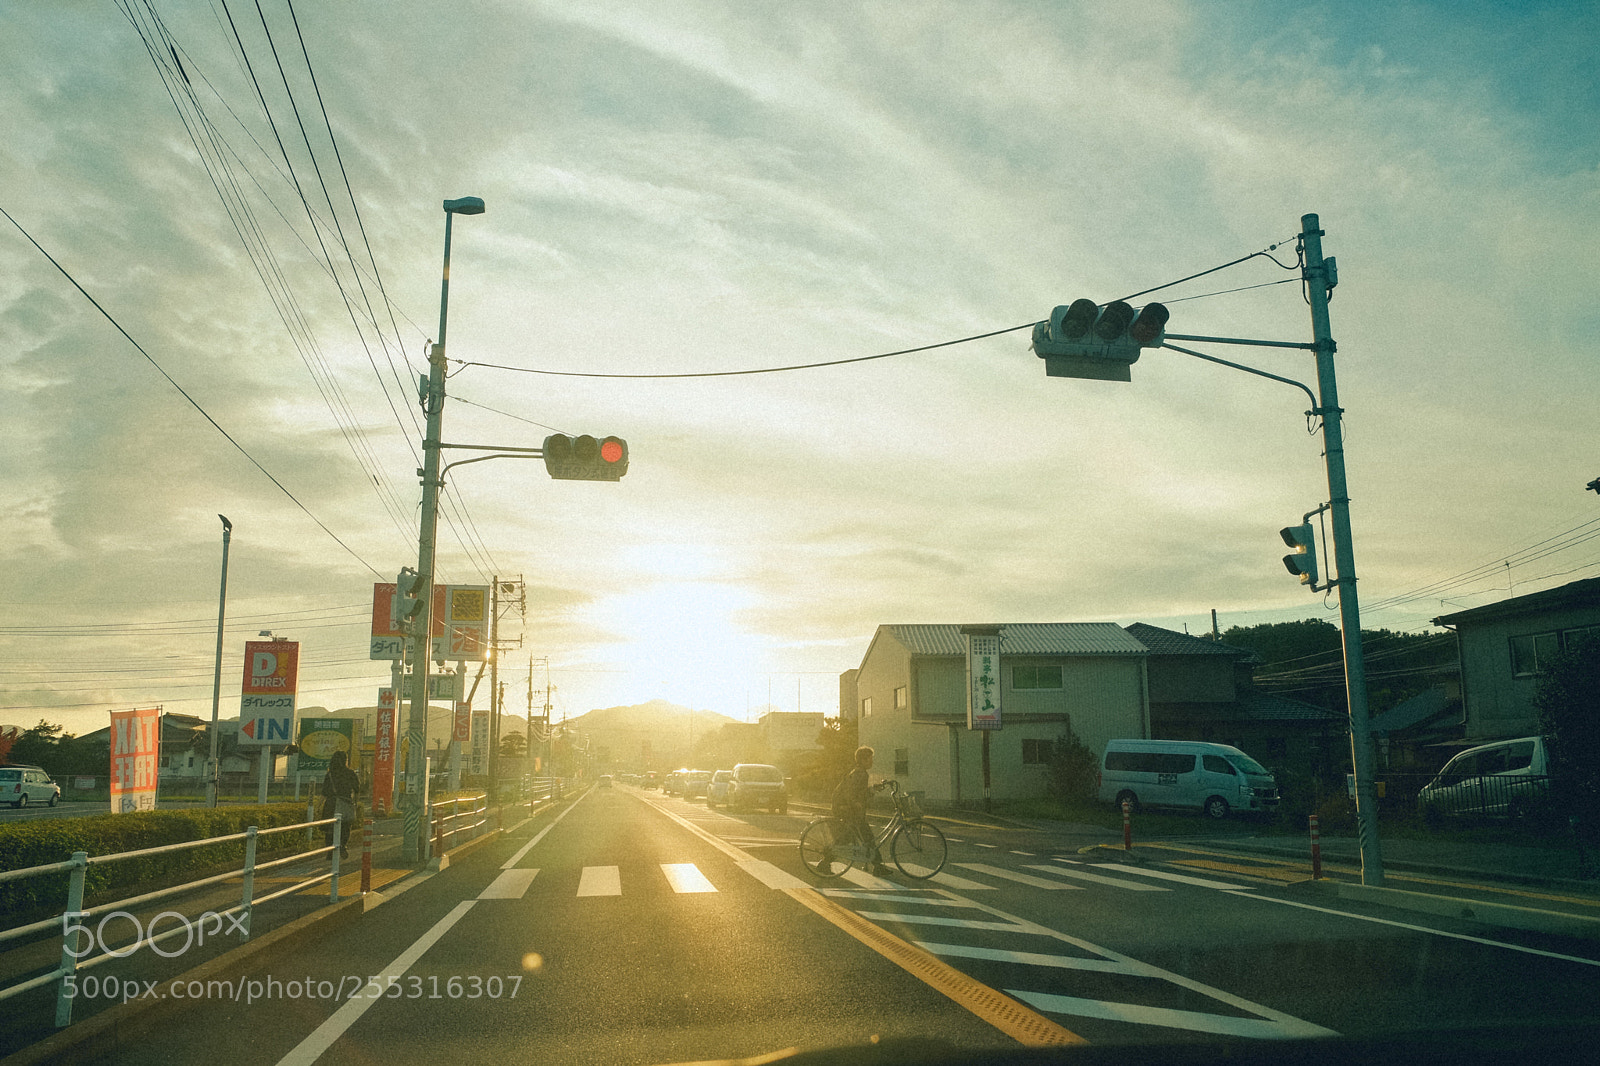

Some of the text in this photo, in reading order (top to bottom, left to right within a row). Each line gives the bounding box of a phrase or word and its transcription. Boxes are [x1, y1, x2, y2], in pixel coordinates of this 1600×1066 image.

[452, 626, 480, 653] 酒
[243, 697, 292, 708] ダイレックス
[257, 718, 289, 740] IN
[378, 711, 392, 762] 佐賀銀行
